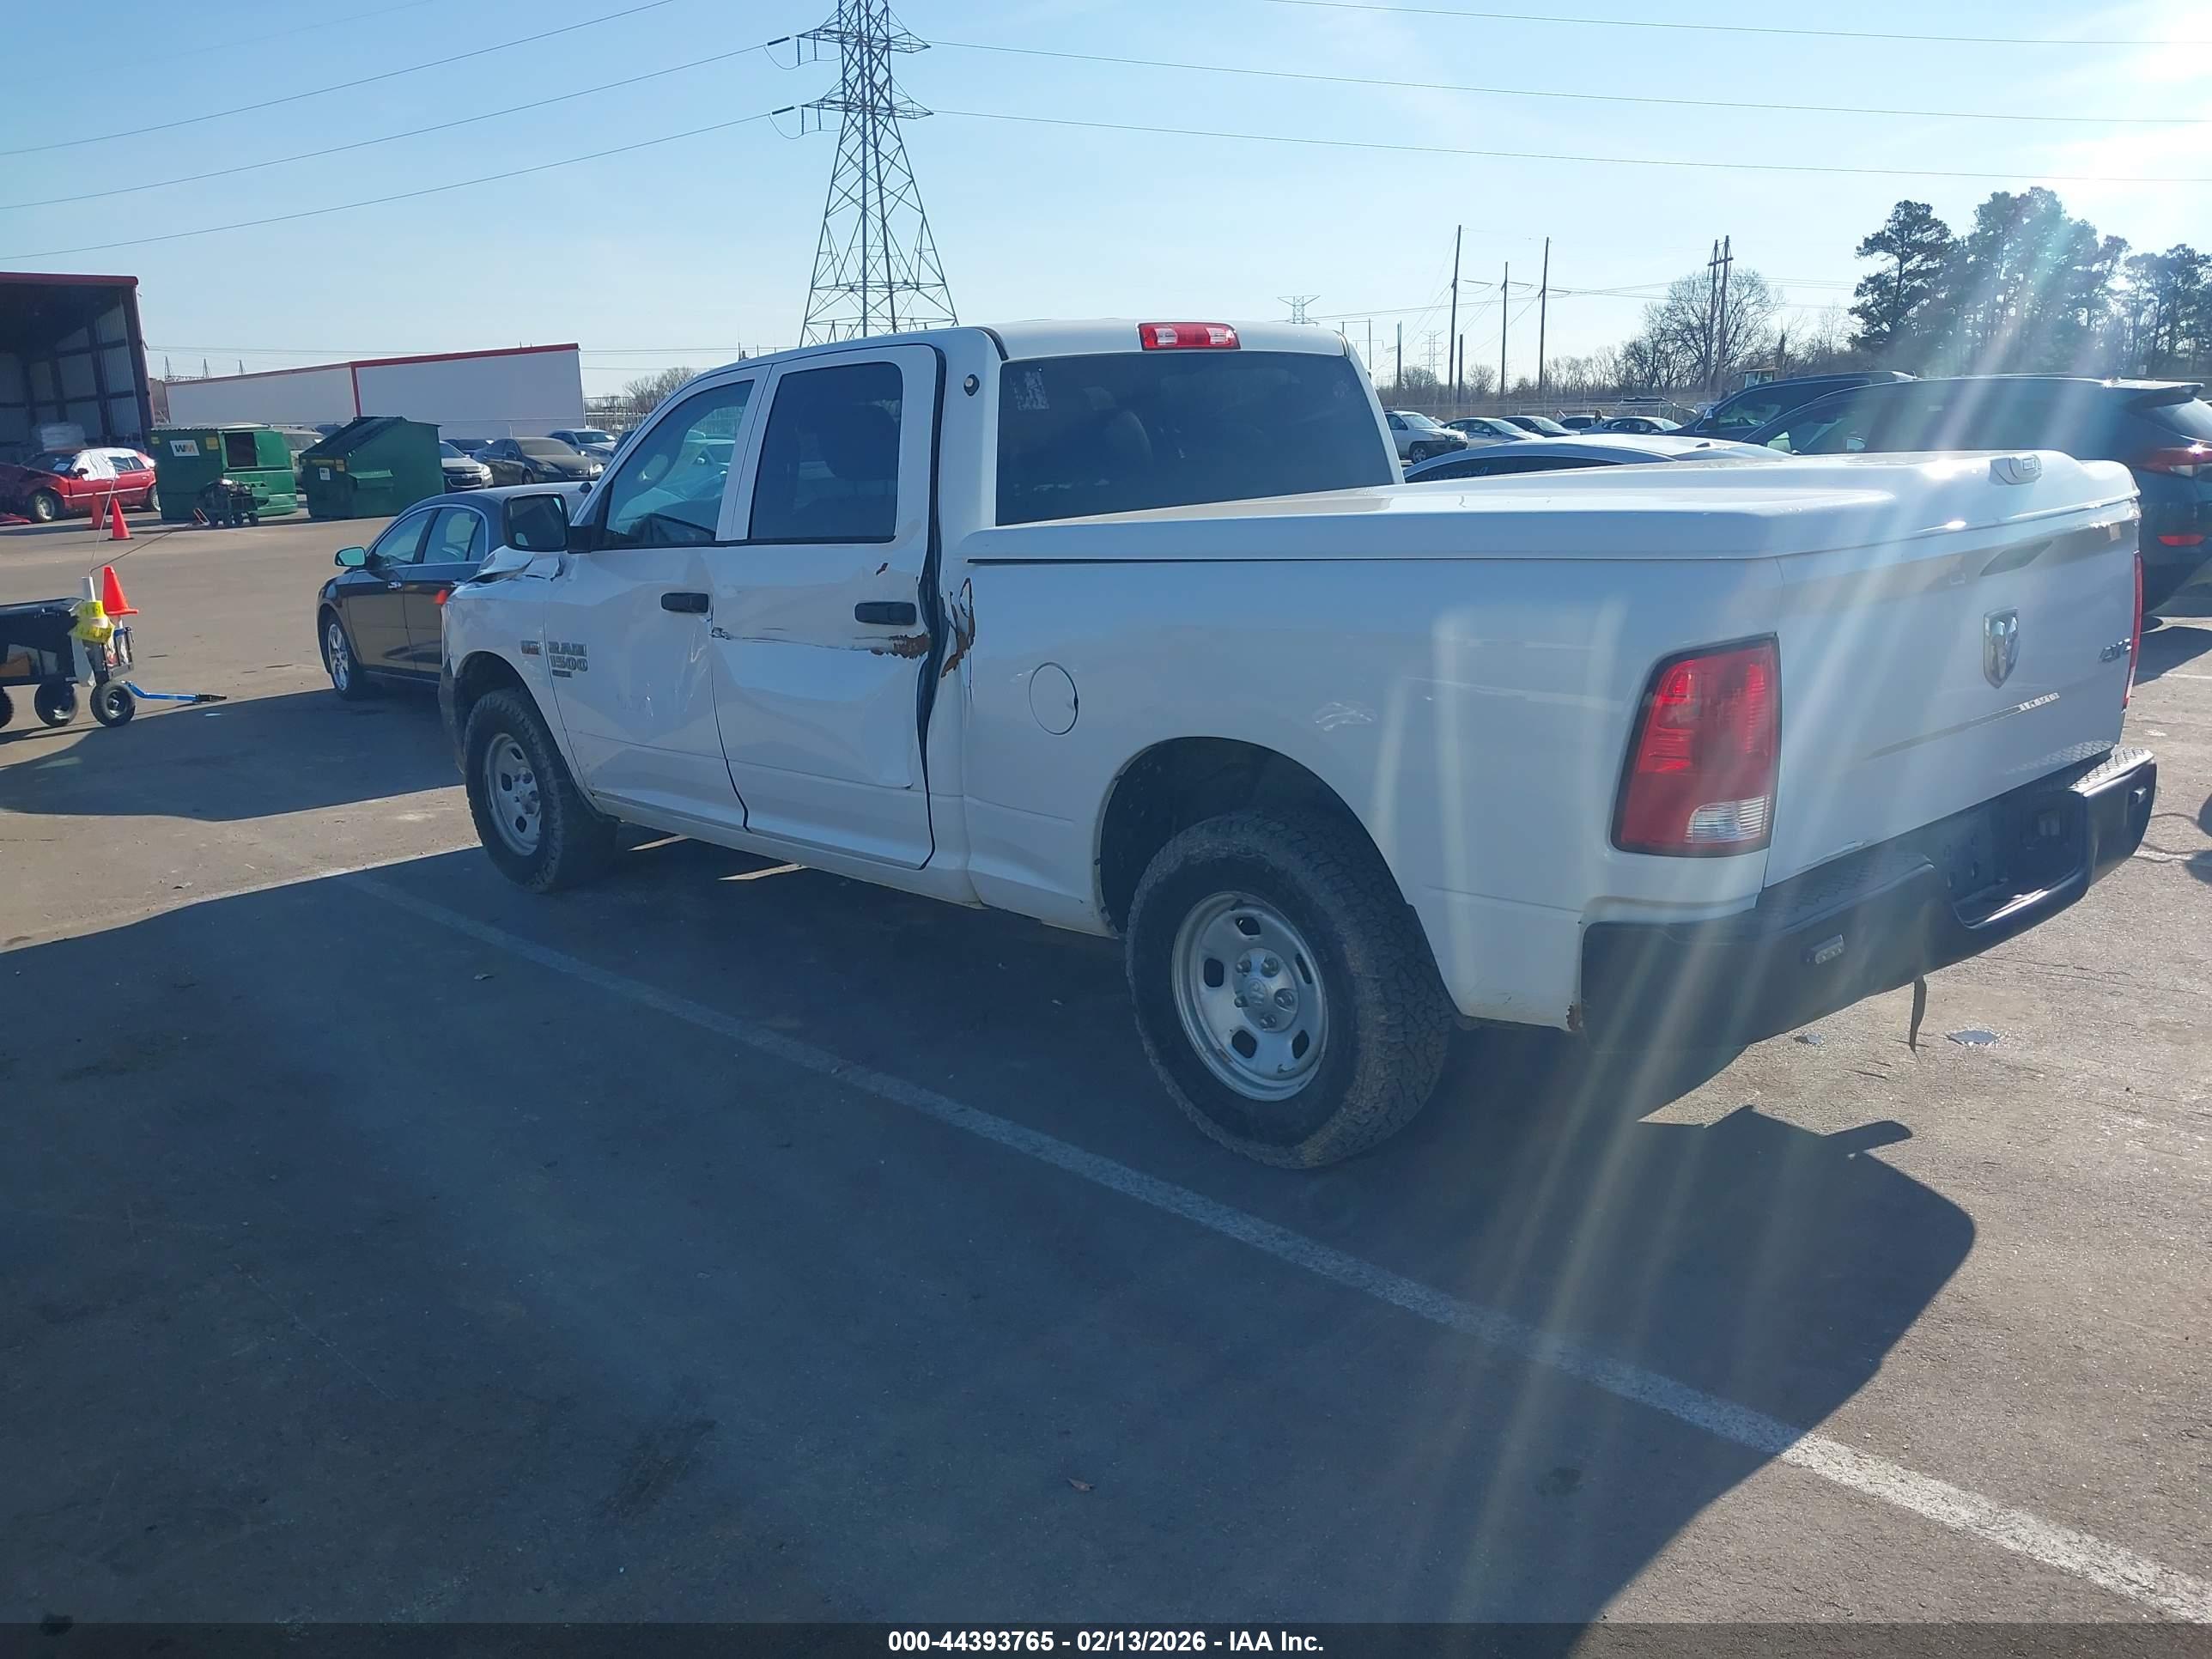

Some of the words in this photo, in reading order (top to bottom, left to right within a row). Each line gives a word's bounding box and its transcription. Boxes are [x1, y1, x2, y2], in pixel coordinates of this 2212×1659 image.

[174, 444, 196, 453] WM
[548, 641, 587, 657] RAM
[550, 655, 588, 672] 1500
